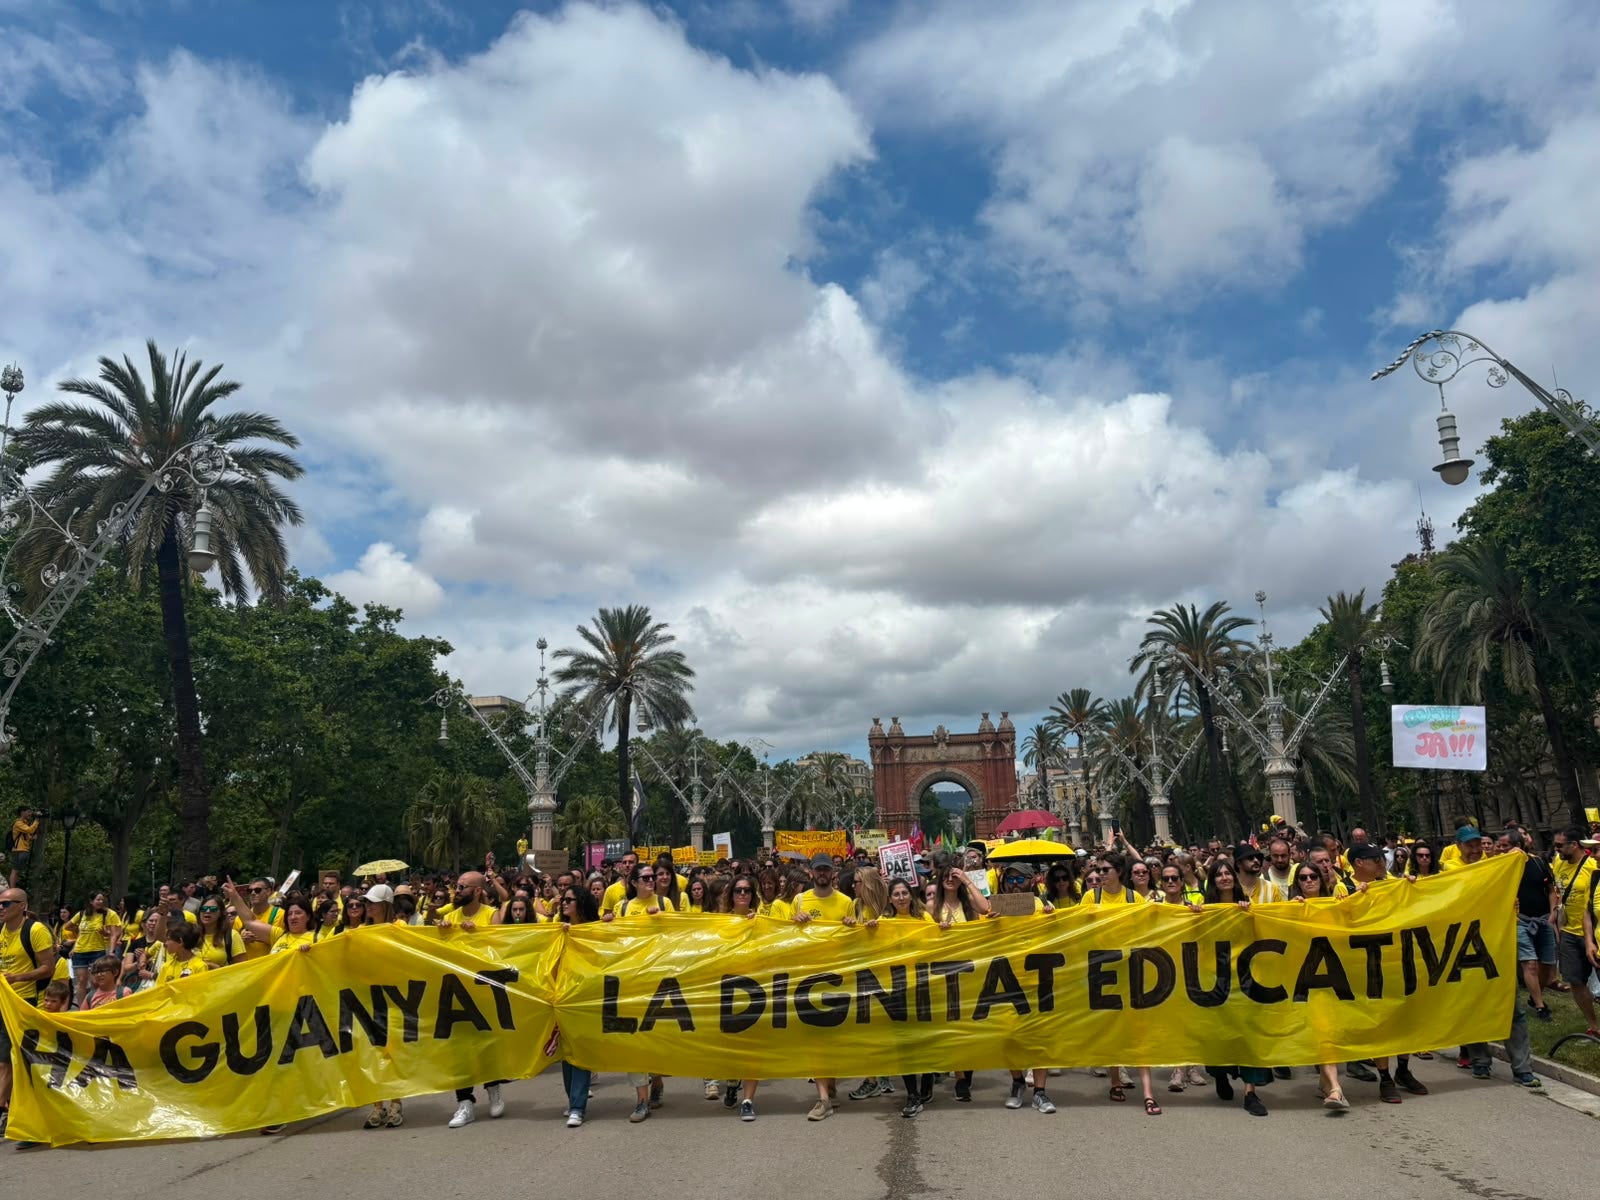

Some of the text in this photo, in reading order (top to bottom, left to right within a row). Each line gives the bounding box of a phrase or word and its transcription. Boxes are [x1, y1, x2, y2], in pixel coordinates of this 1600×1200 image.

[886, 858, 911, 876] PAE
[20, 919, 1500, 1089] HA GUANYAT LA DIGNITAT EDUCATIVA
